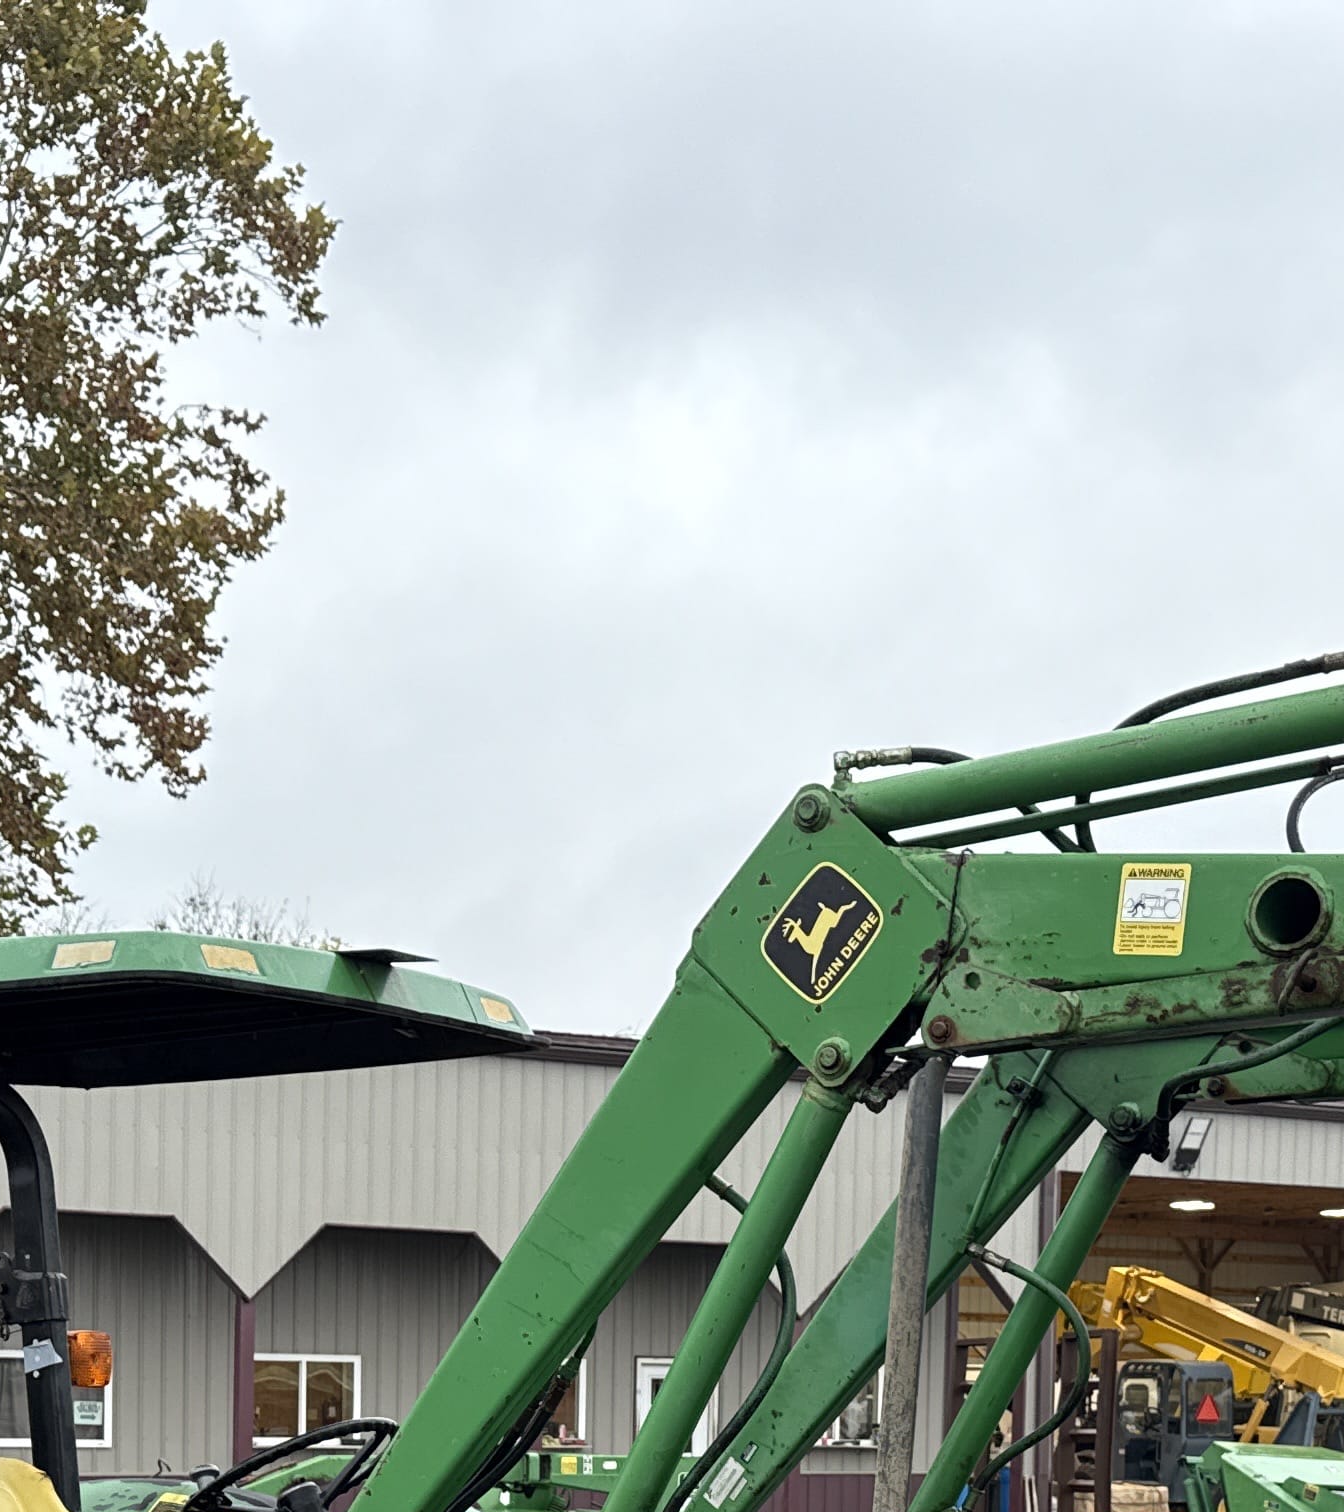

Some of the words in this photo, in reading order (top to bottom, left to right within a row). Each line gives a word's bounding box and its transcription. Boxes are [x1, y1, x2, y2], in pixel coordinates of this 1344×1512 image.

[1138, 868, 1184, 878] WARNING
[814, 957, 844, 996] JOHN
[840, 911, 878, 959] DEERE
